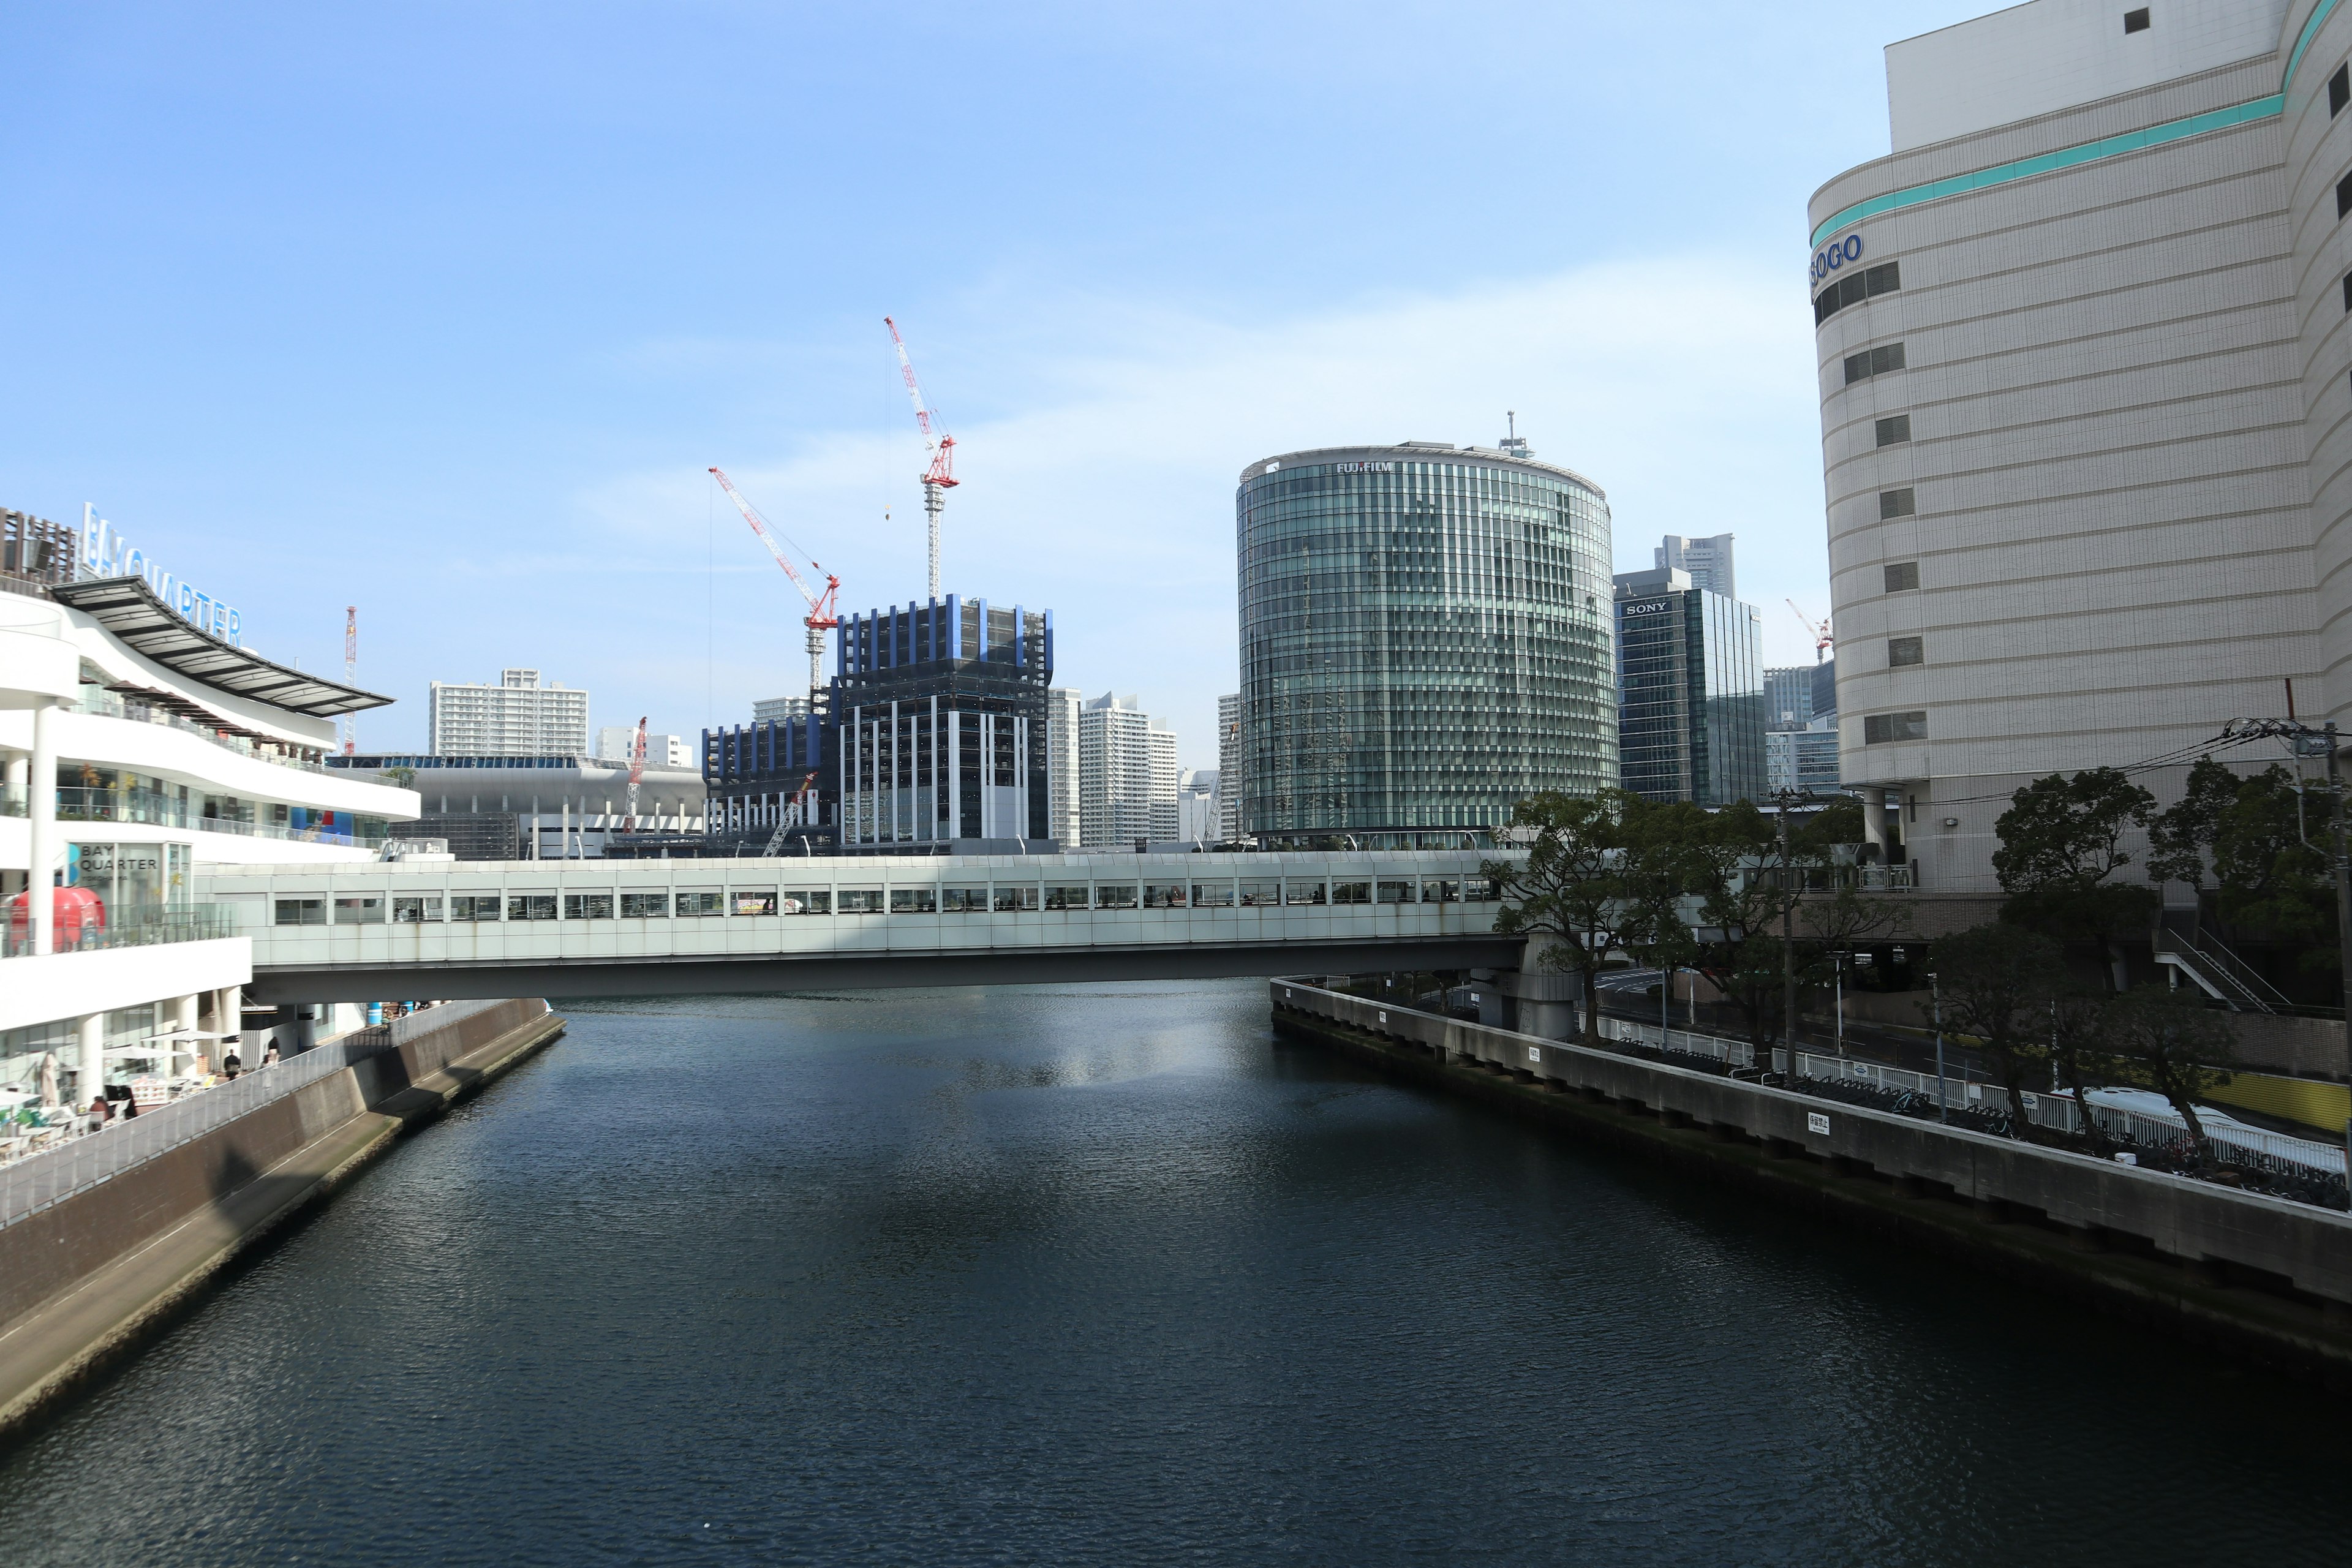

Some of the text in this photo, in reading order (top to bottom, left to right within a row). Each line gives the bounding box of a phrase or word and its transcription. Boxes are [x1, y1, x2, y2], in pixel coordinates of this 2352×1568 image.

[1810, 235, 1863, 286] SOGO
[1627, 602, 1667, 615] SONY
[82, 846, 114, 856] BAY
[81, 859, 157, 872] QUARTER
